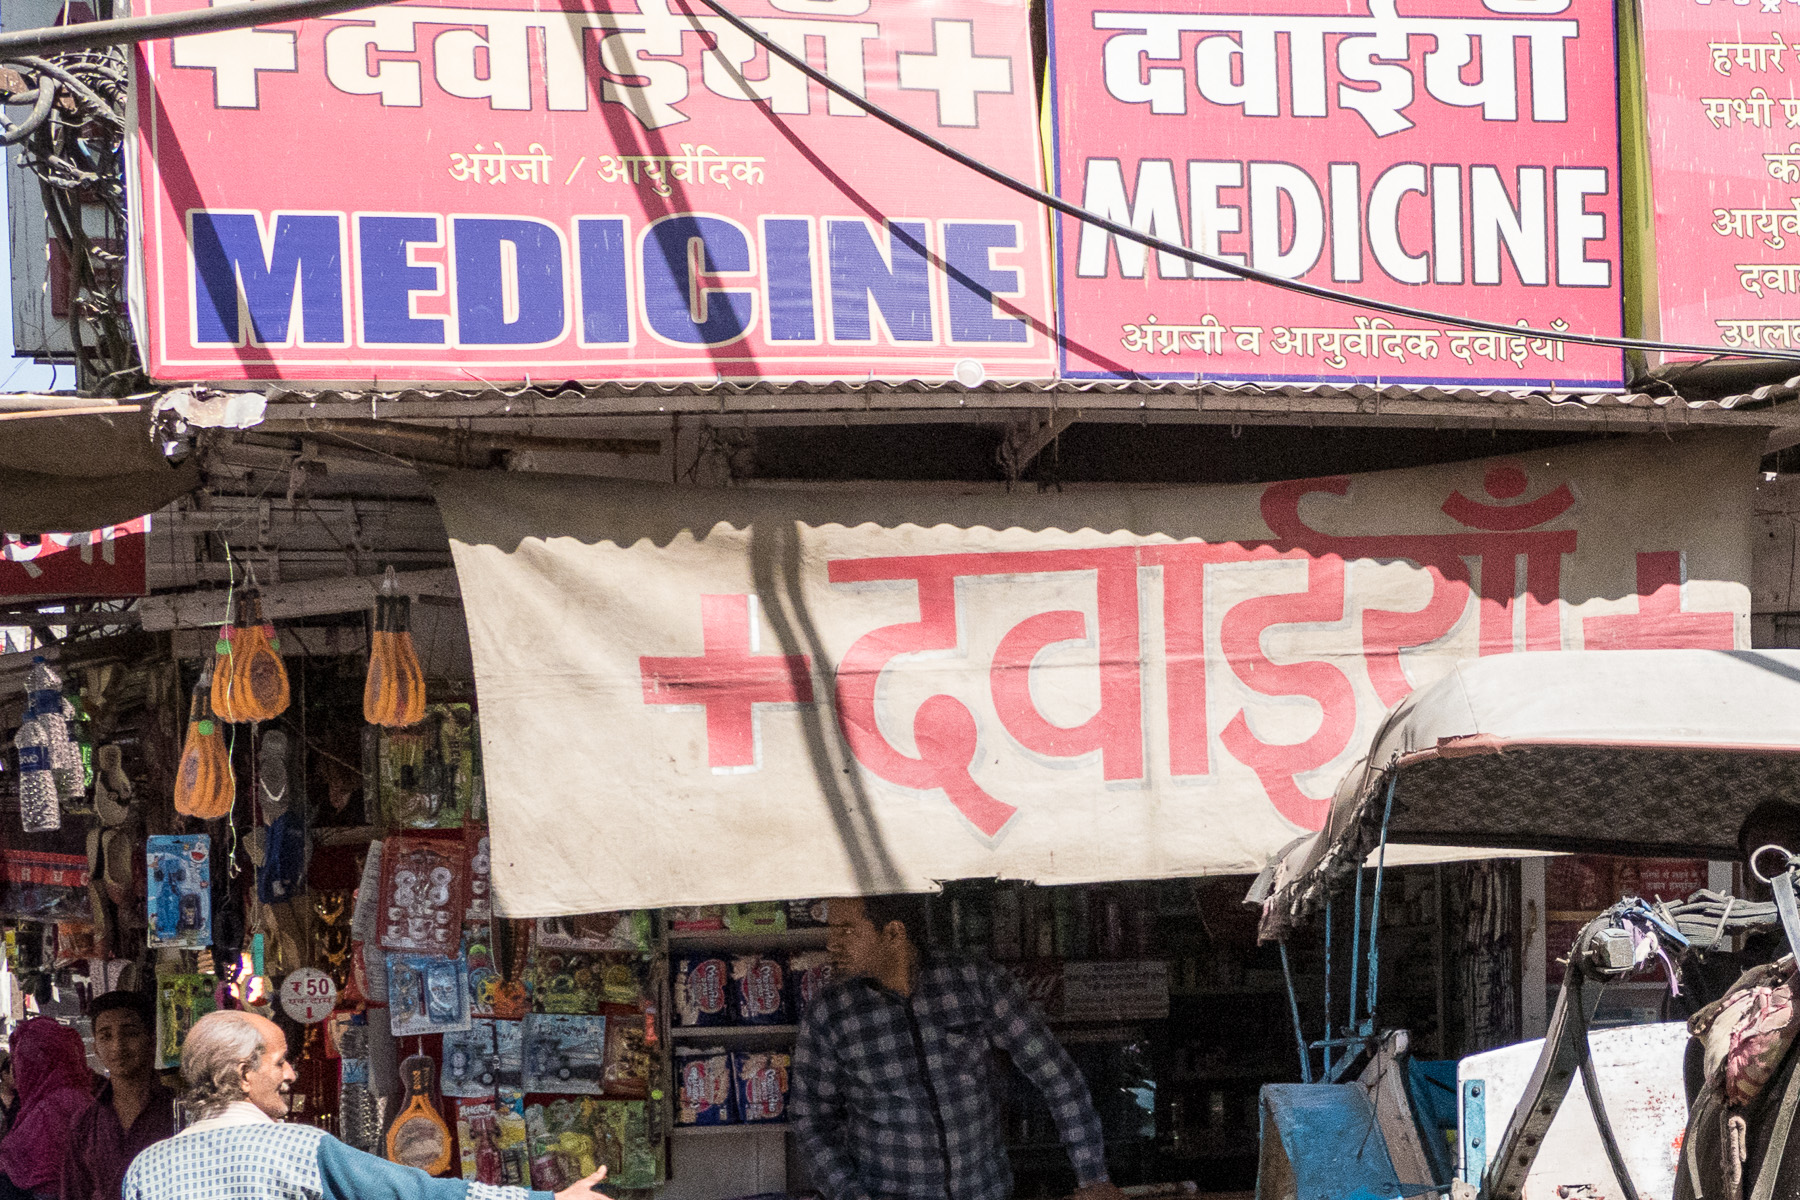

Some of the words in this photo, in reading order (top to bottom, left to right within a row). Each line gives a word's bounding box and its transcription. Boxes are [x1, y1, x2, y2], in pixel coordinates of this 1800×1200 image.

[313, 0, 879, 132] दवाईया
[1707, 31, 1788, 77] हमारे
[1700, 87, 1775, 129] सभी
[448, 142, 553, 185] अंग्रेजी
[597, 143, 766, 198] आयुर्वेदिक
[1076, 157, 1613, 288] MEDICINE
[188, 208, 1033, 350] MEDICINE
[1120, 314, 1226, 355] अंग्रजी
[1232, 326, 1263, 356] व
[1270, 316, 1440, 370] आयुर्वेदिक
[1446, 318, 1570, 364] दवाईयाँ
